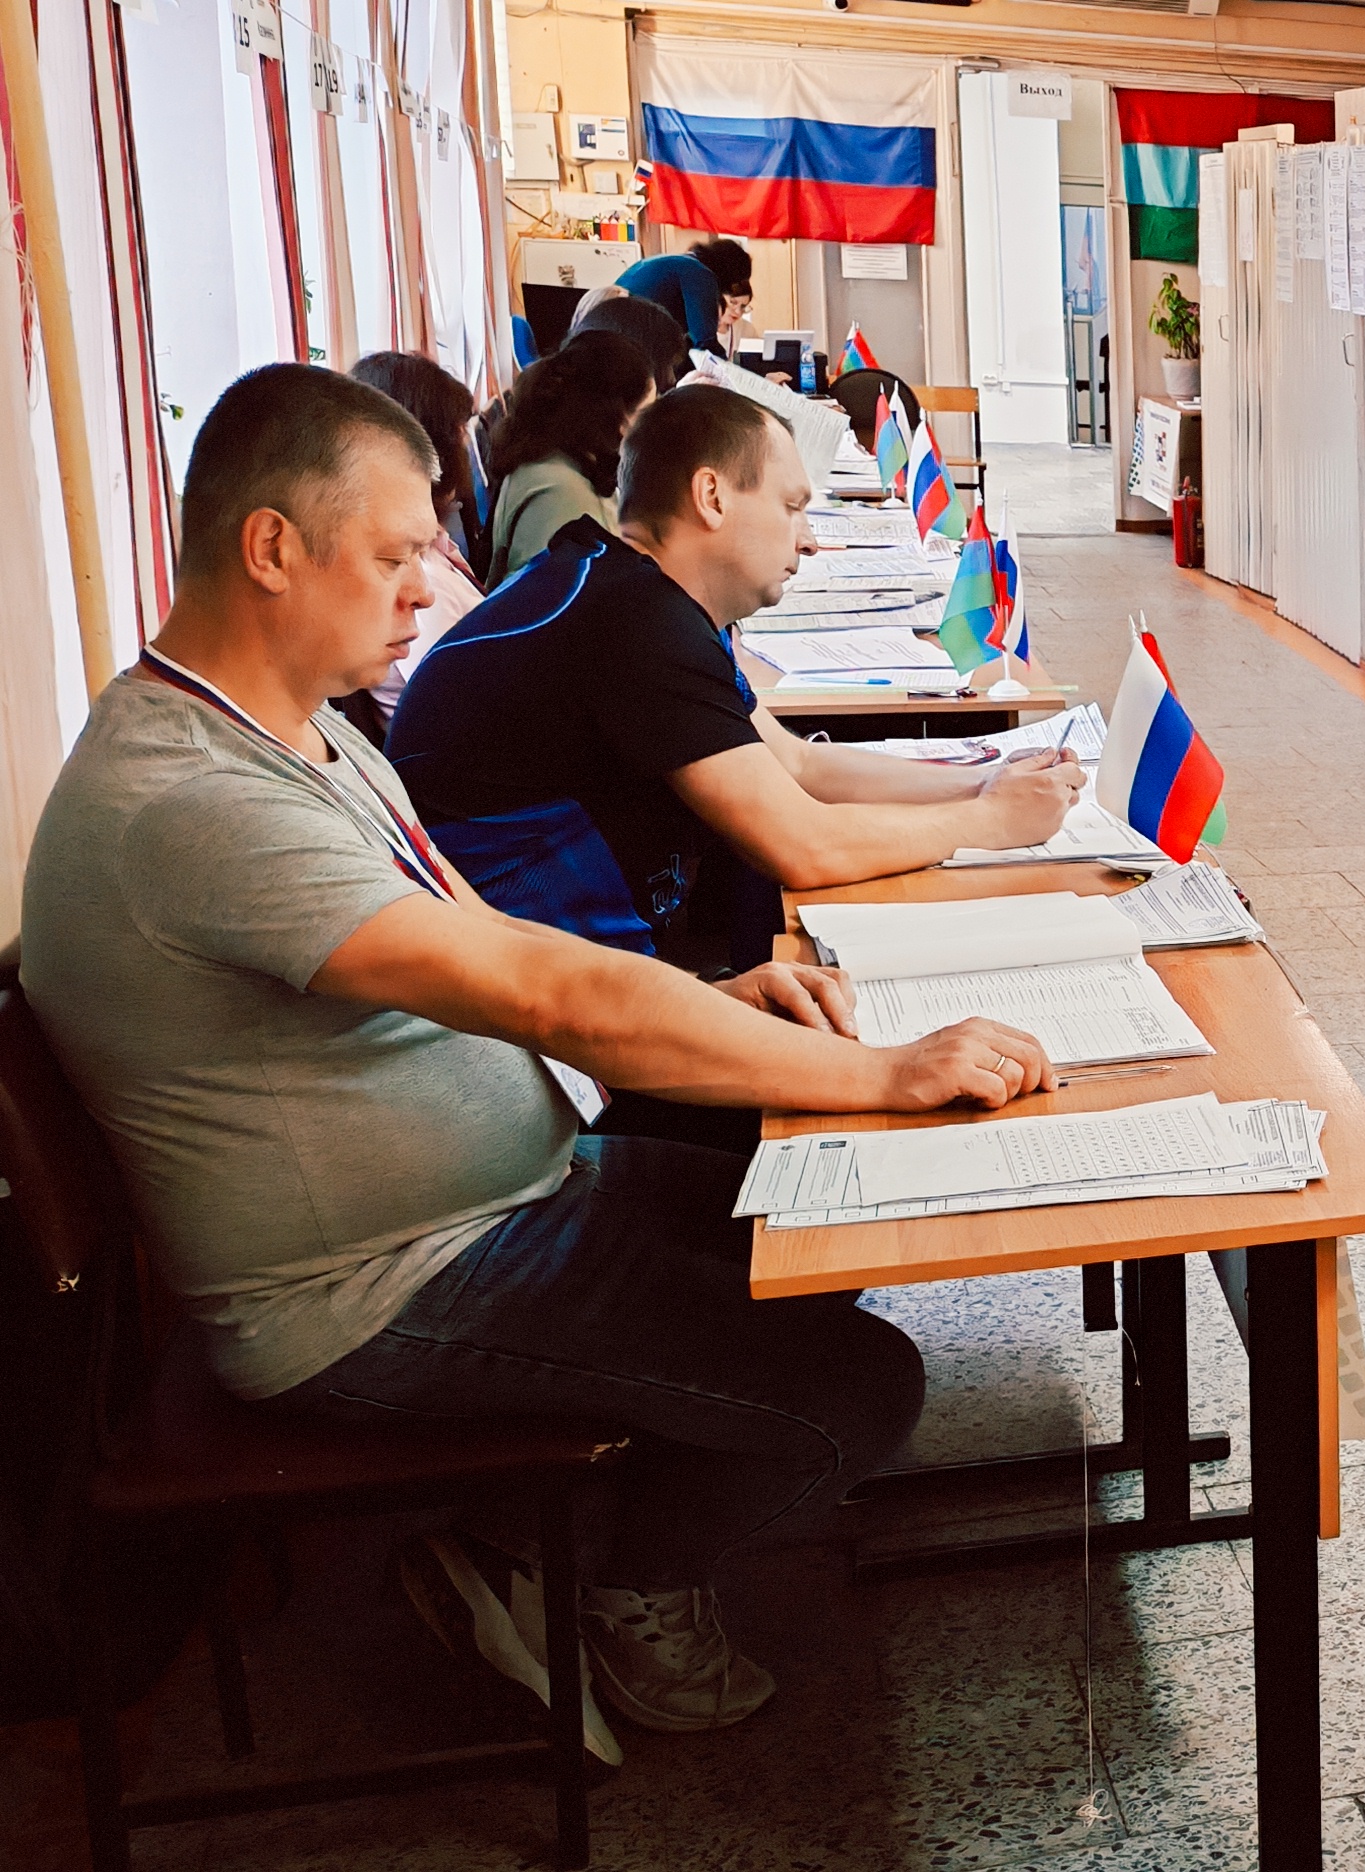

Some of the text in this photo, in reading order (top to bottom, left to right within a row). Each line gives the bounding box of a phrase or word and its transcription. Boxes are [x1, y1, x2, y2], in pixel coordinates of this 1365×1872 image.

[239, 15, 250, 48] 15
[314, 62, 323, 87] 17
[1020, 83, 1063, 97] Выход
